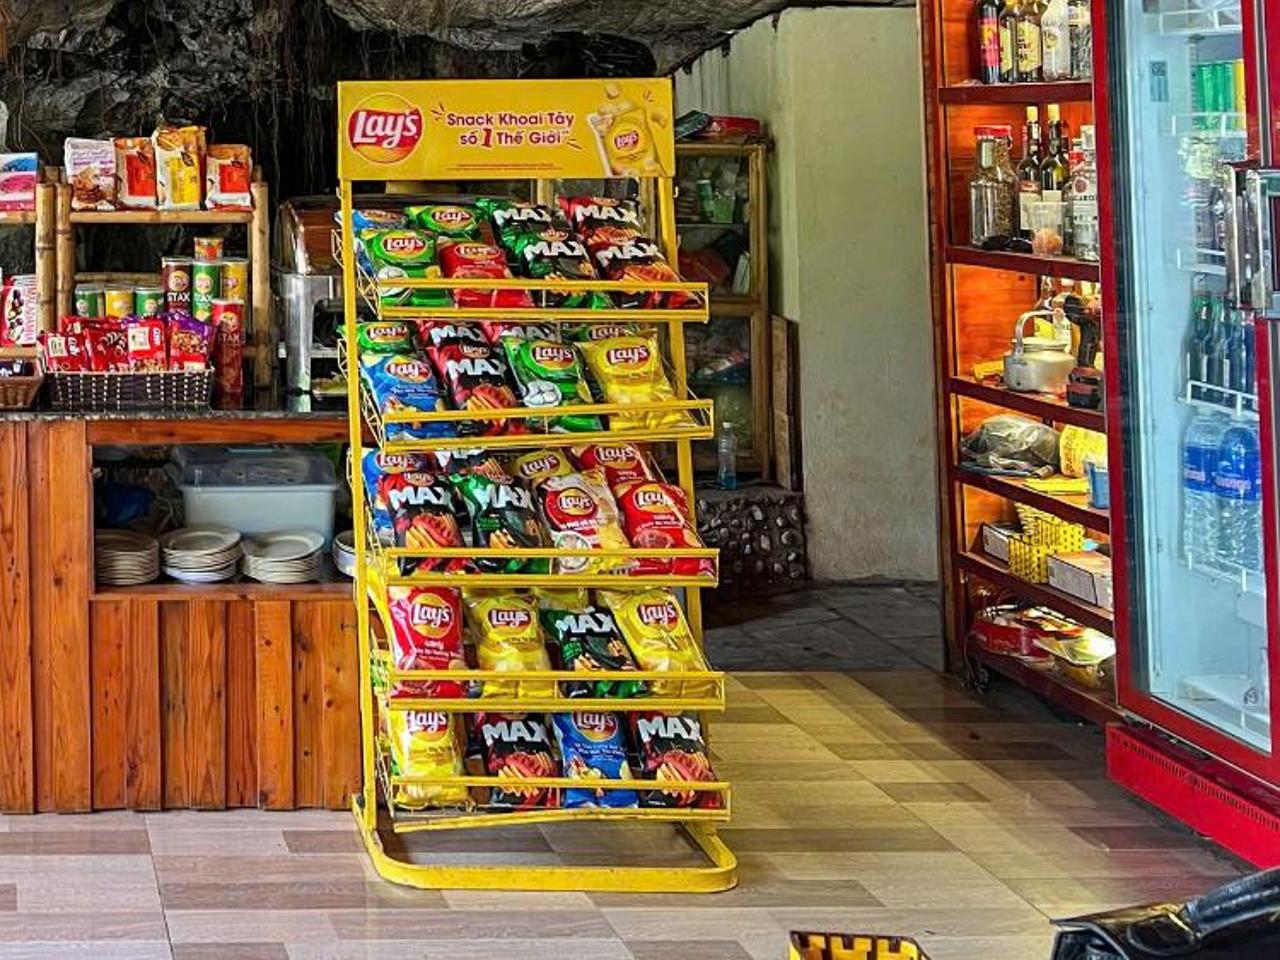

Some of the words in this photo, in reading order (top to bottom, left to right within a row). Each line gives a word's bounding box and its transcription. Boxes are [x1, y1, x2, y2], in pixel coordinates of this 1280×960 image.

[354, 111, 419, 146] Lay's
[447, 112, 494, 127] Snack
[499, 112, 544, 126] Khoai
[548, 112, 575, 132] Tây
[481, 128, 493, 148] 1
[497, 131, 523, 145] Thế
[576, 206, 640, 226] MAX
[385, 237, 424, 252] Lay's
[524, 239, 586, 260] MAX
[597, 243, 661, 267] MAX
[167, 292, 190, 302] STAX
[535, 346, 572, 367] Lay's
[608, 343, 649, 365] Lay's
[522, 453, 560, 472] Lay's
[596, 445, 637, 466] Lay's
[388, 486, 453, 510] MAX
[559, 495, 595, 515] Lay's
[411, 603, 451, 628] Lay's
[490, 608, 529, 627] Lay's
[555, 610, 618, 637] MAX
[639, 602, 676, 626] Lay's
[482, 720, 550, 744] MAX
[637, 716, 703, 742] MAX
